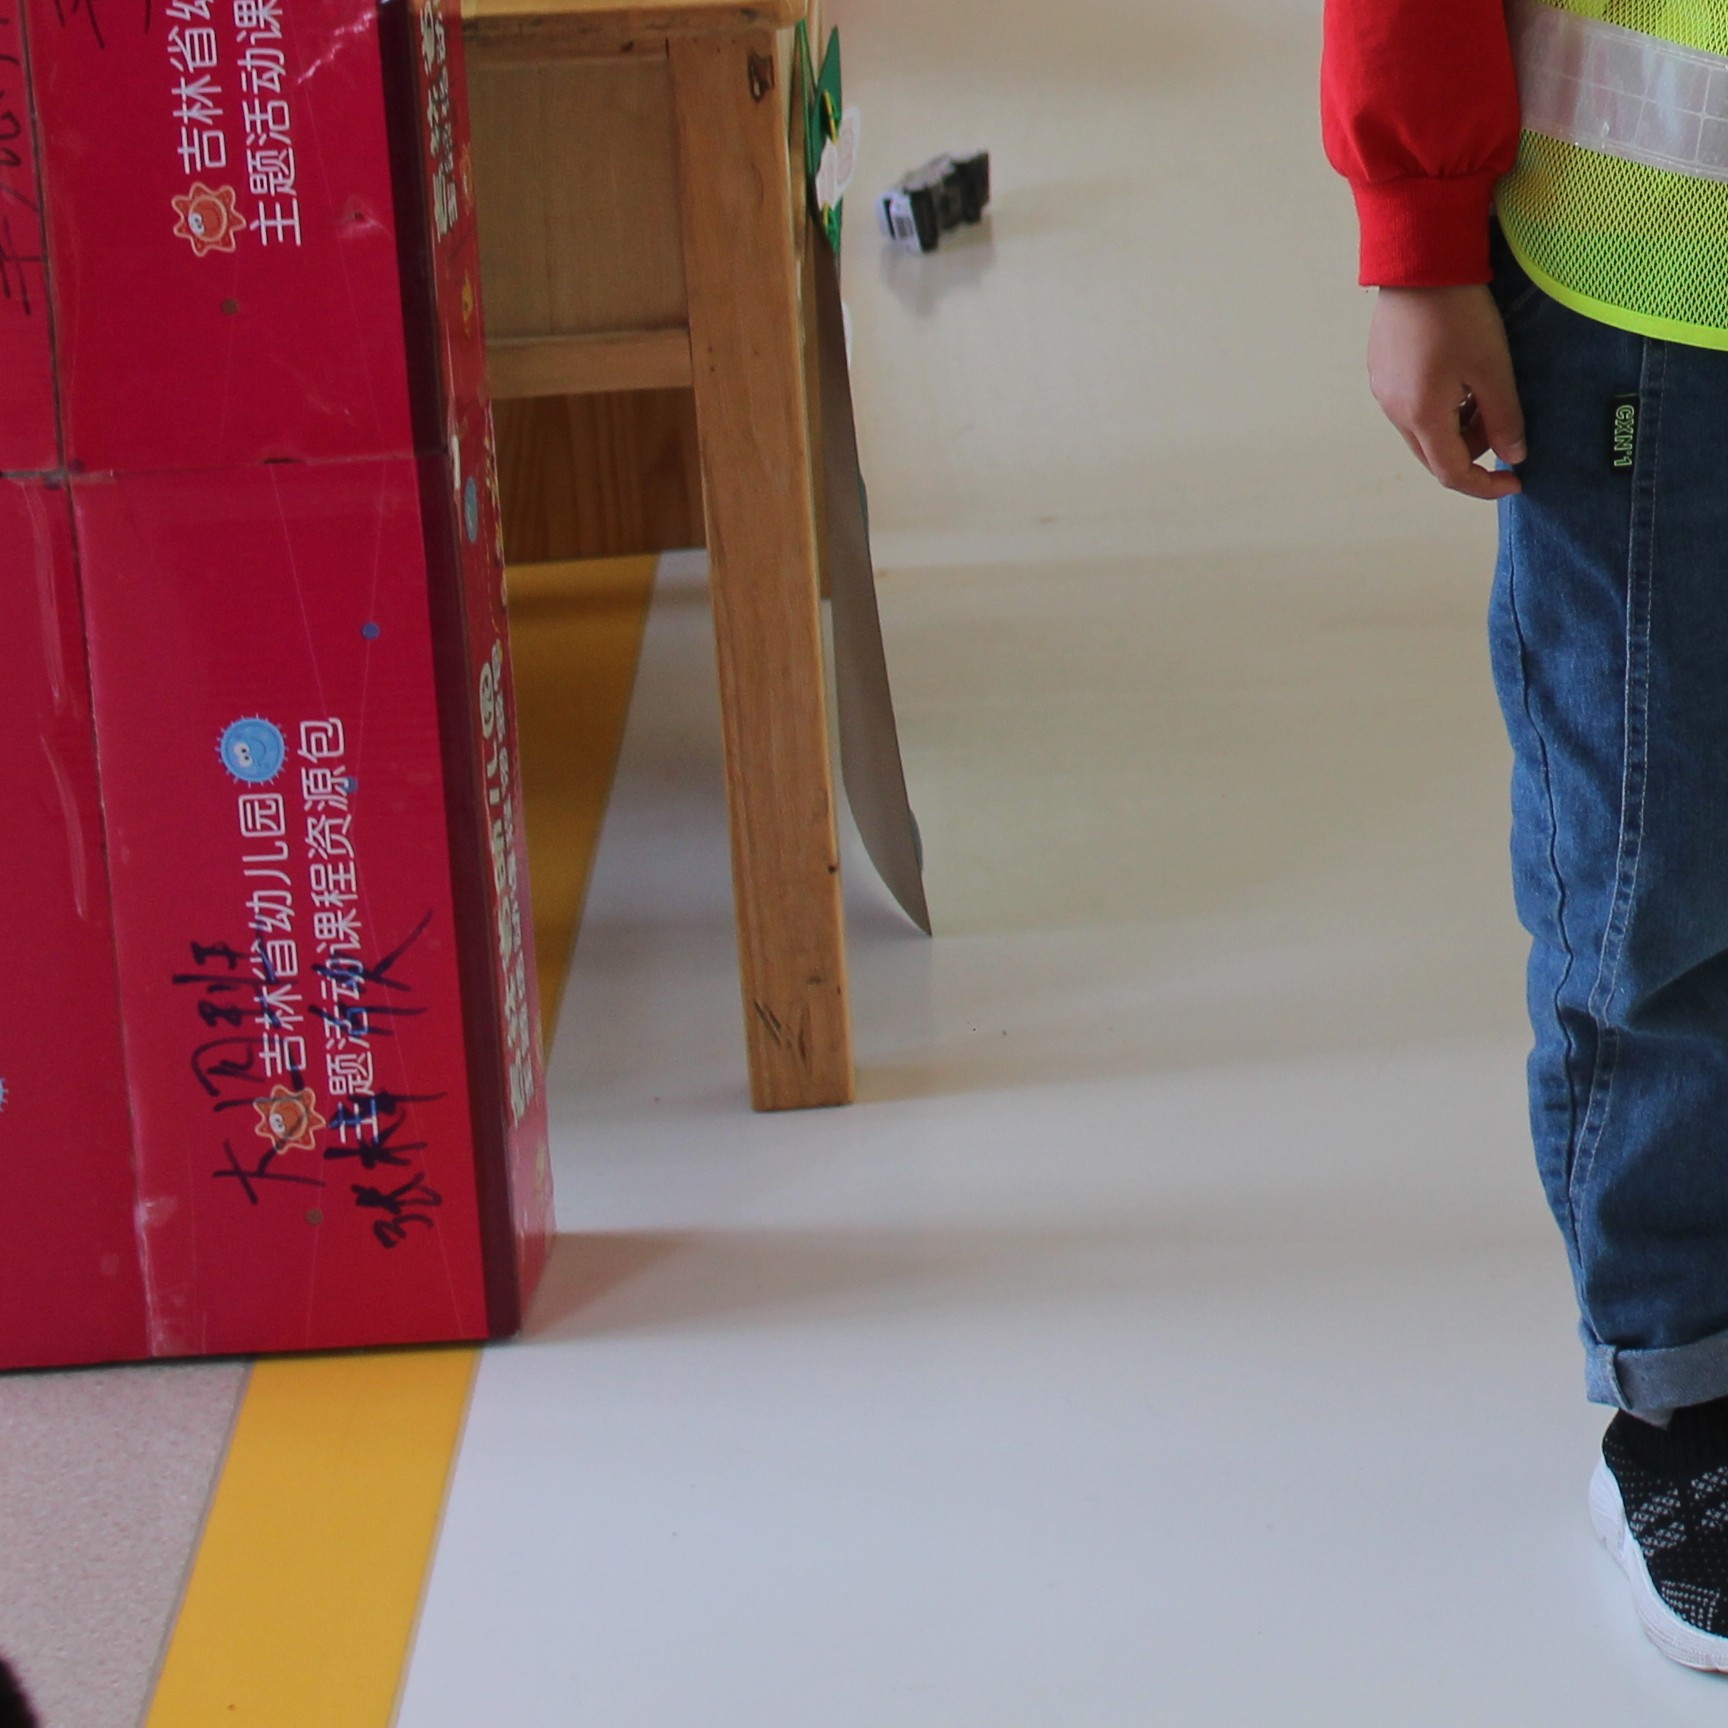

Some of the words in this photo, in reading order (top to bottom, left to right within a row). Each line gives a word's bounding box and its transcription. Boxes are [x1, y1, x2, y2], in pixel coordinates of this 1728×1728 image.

[238, 791, 311, 1078] 吉林省幼儿园
[296, 717, 382, 1146] 主题活动课程资源包
